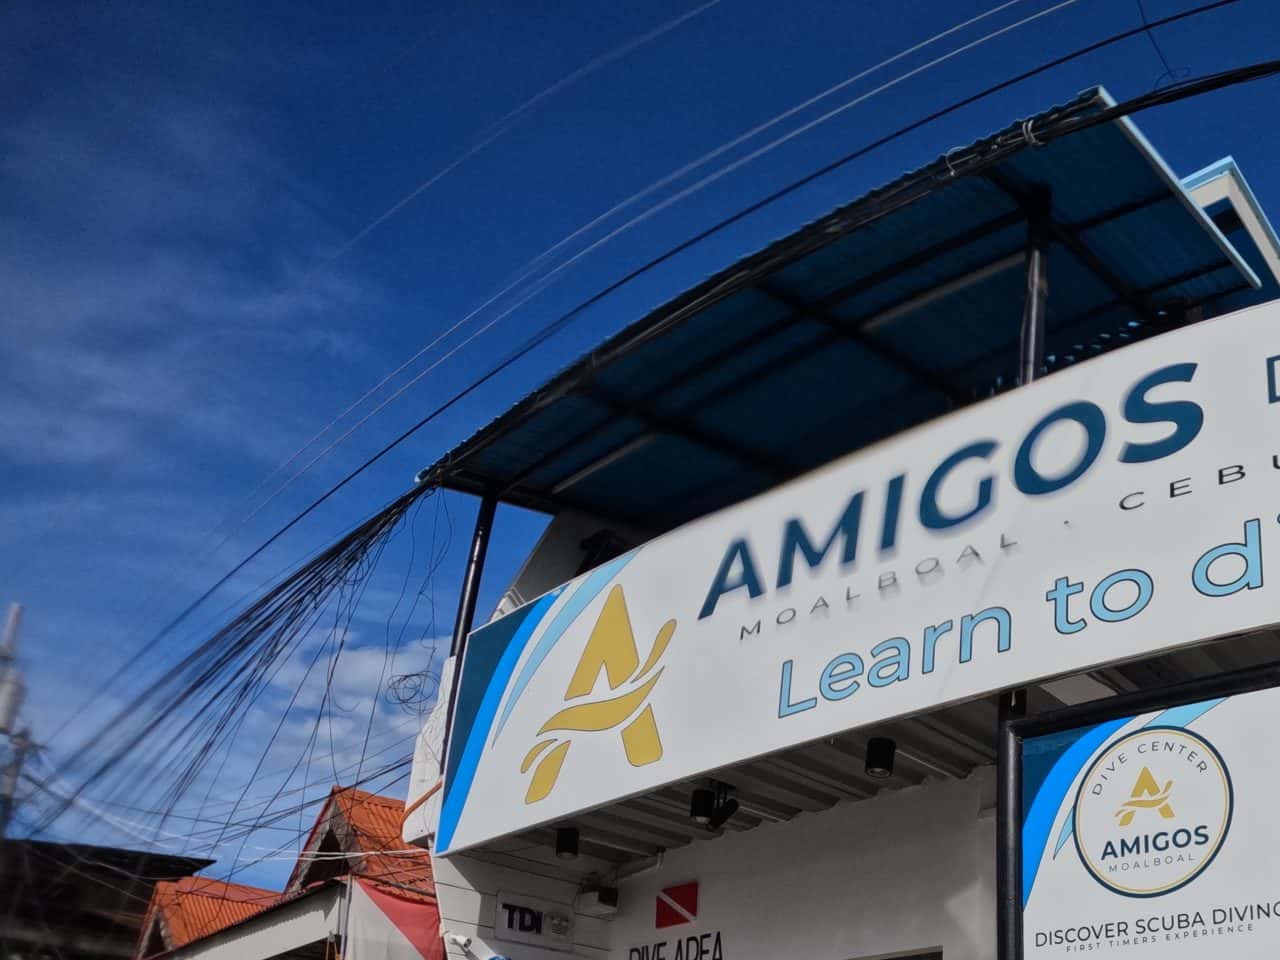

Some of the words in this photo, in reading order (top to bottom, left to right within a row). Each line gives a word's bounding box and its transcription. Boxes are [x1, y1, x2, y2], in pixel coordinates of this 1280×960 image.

[697, 362, 1204, 622] AMIGOS
[738, 533, 1019, 641] MOALBOAL
[778, 604, 1013, 720] Learn
[1045, 568, 1155, 636] to
[1091, 752, 1129, 797] DIVE
[1136, 740, 1209, 775] CENTER
[1100, 825, 1210, 861] AMIGOS
[1108, 852, 1196, 873] MOALBOAL
[502, 903, 544, 935] TDI
[1035, 920, 1129, 948] DISCOVER
[1135, 911, 1205, 935] SCUBA
[1066, 941, 1103, 953] FIRST
[1109, 935, 1157, 949] TIMERS
[1165, 922, 1255, 941] EXPERIENCE
